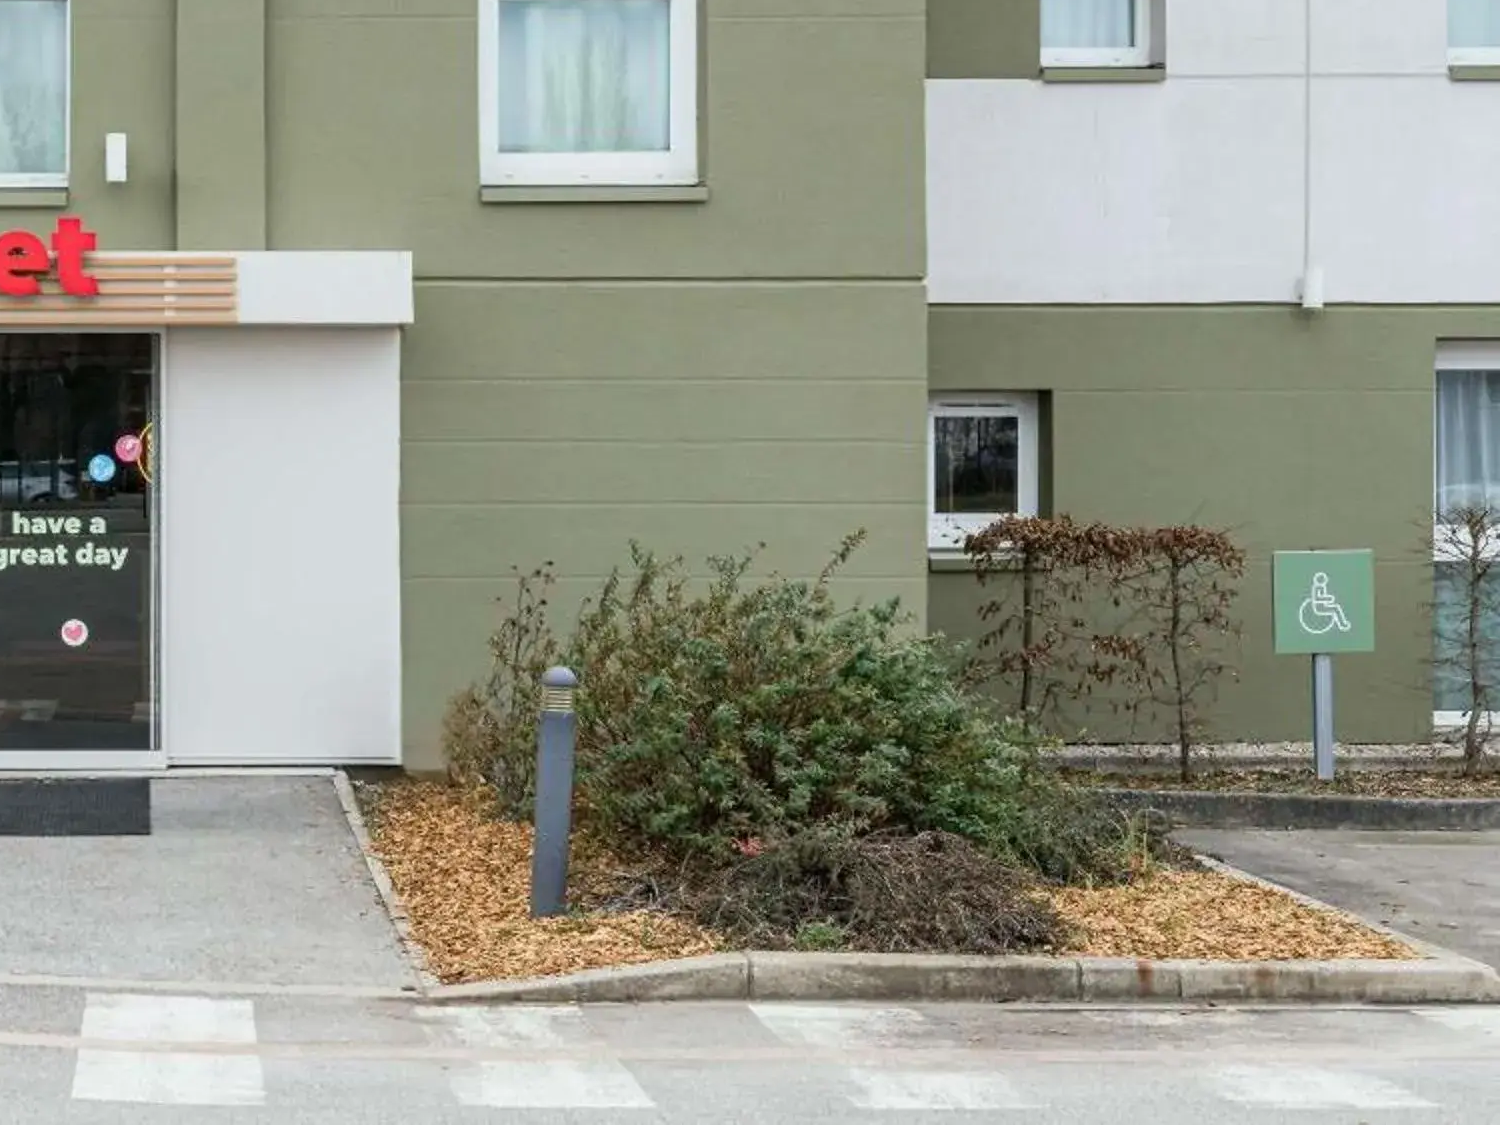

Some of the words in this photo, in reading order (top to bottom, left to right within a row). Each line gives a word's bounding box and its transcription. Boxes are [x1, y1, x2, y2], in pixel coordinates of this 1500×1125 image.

[12, 511, 82, 534] have
[89, 516, 107, 534] a
[75, 542, 129, 571] day
